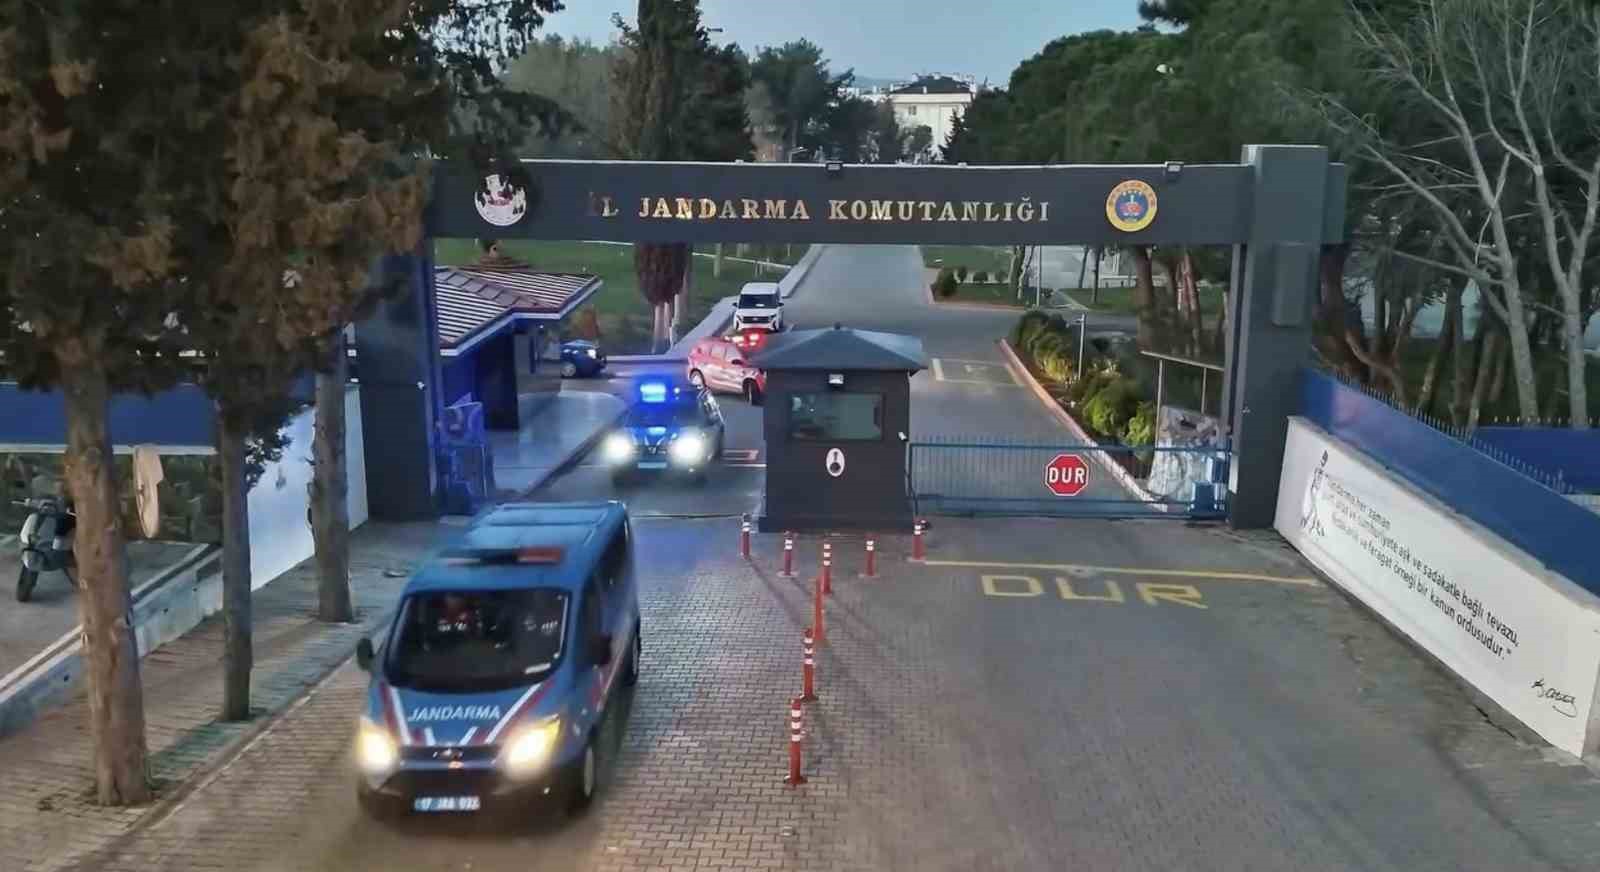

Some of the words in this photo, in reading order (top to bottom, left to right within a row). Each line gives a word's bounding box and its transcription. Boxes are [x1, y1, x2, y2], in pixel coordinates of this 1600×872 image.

[638, 197, 810, 219] JANDARMA
[828, 197, 1049, 221] KOMUTANLIĞI
[1049, 466, 1085, 484] DUR
[981, 574, 1209, 609] DUR
[1413, 557, 1422, 571] ve
[1423, 564, 1461, 601] sadakatle
[1462, 588, 1484, 619] bağlı
[1486, 611, 1518, 648] tevazu,
[1417, 578, 1428, 597] bir
[1430, 587, 1455, 618] kanun
[407, 704, 500, 722] JANDARMA
